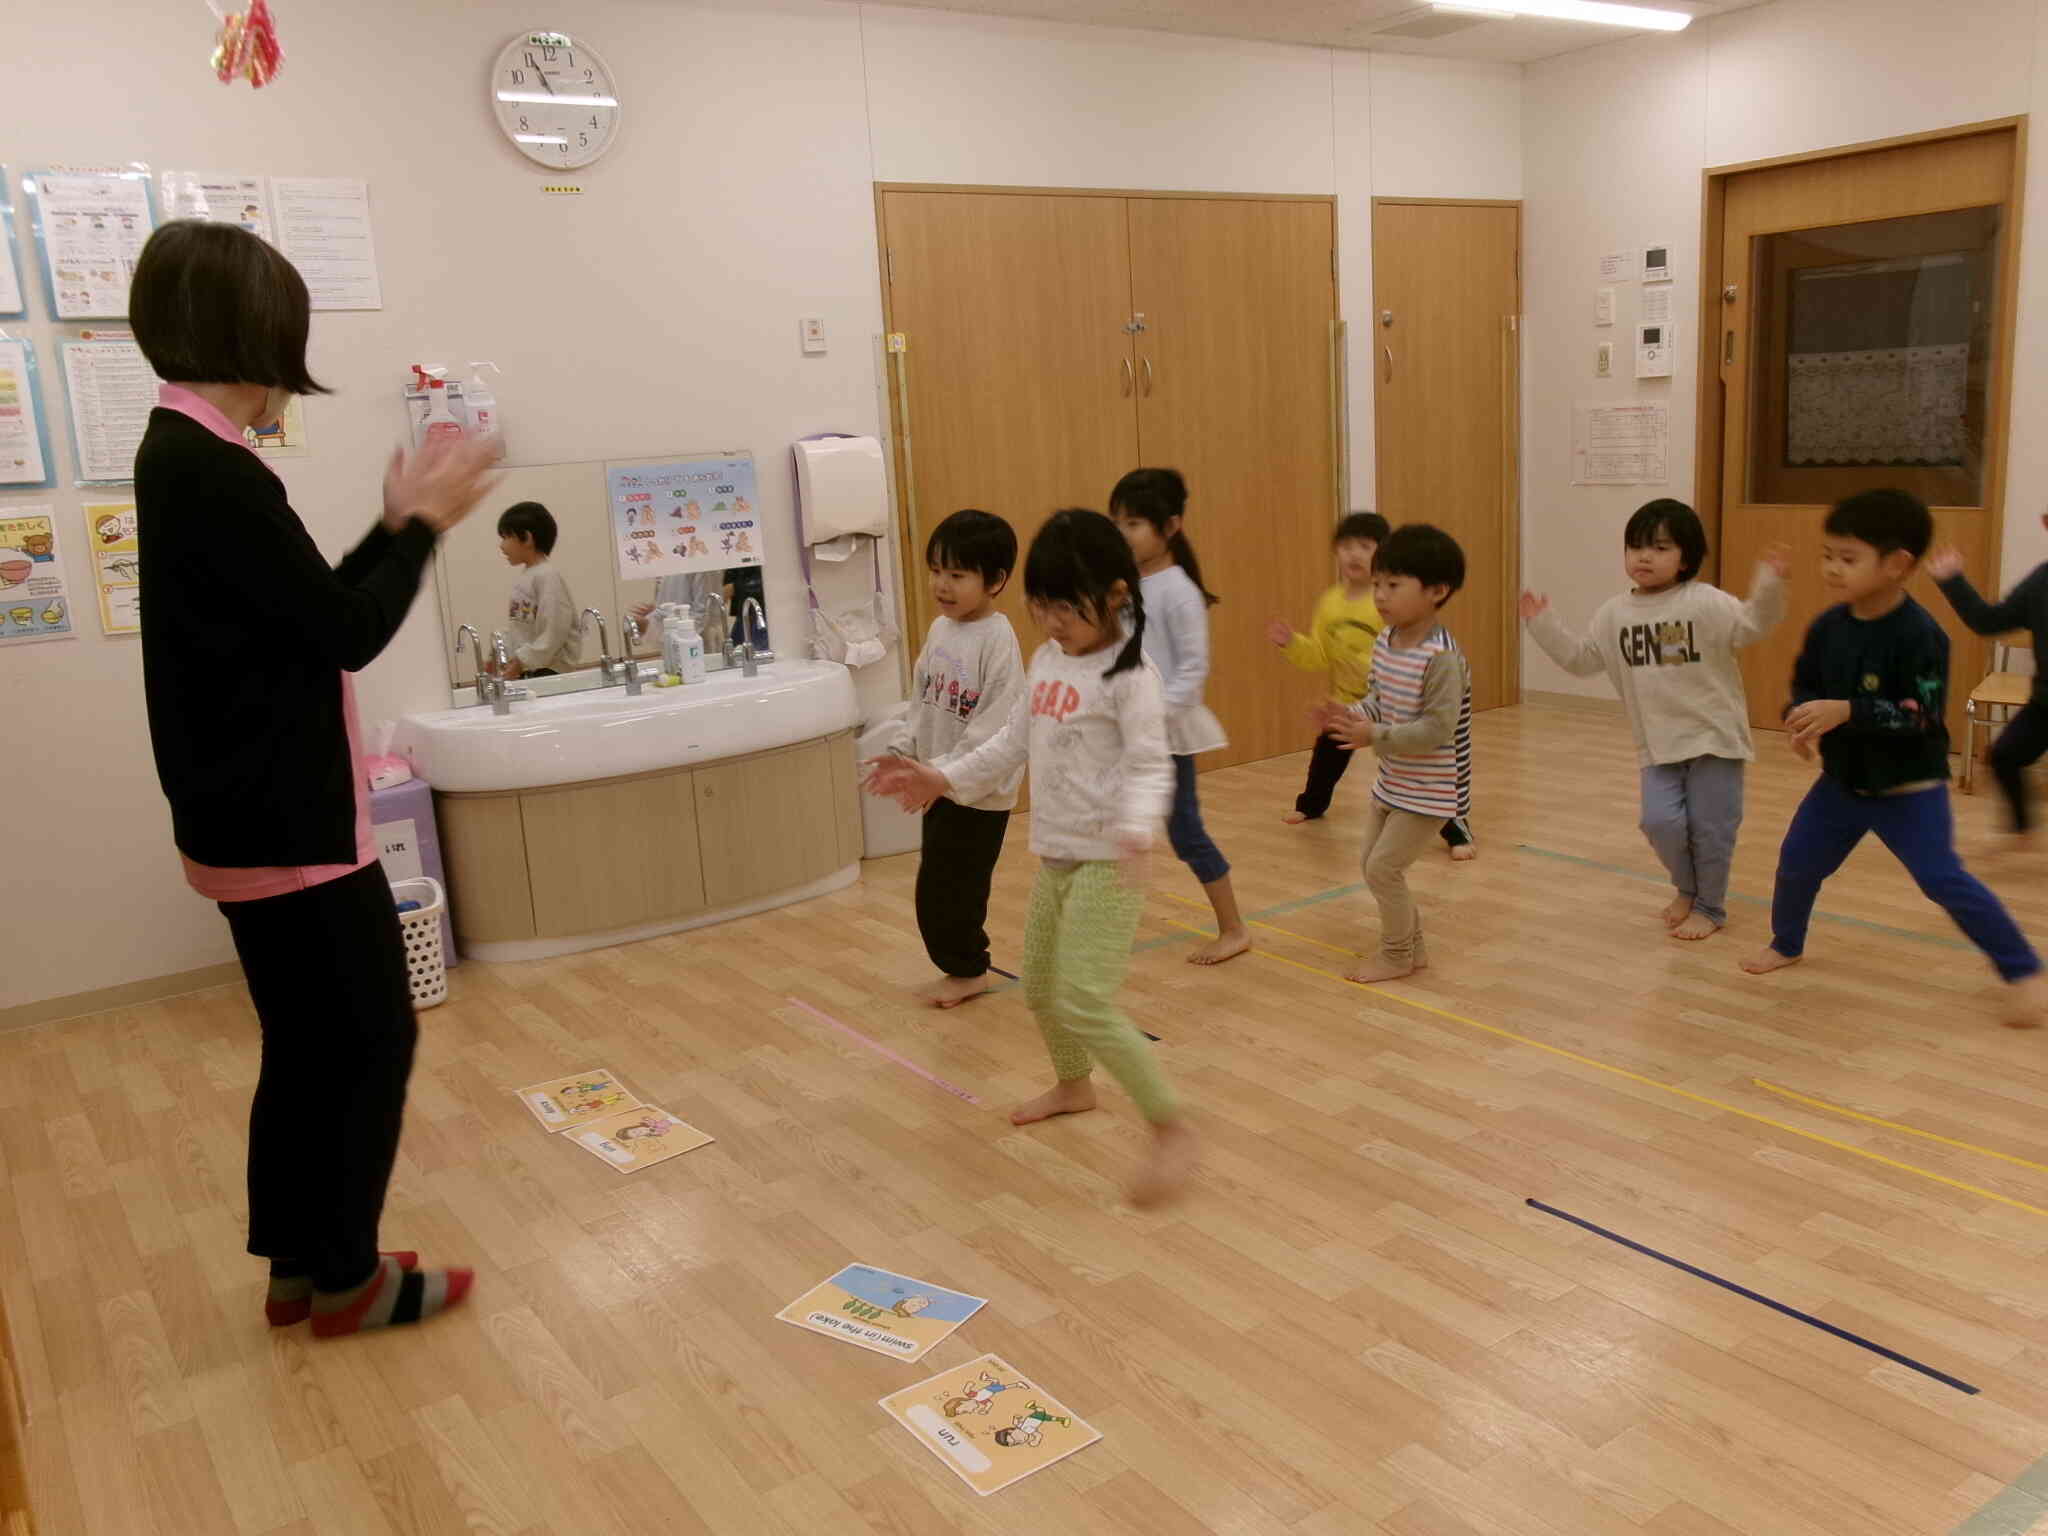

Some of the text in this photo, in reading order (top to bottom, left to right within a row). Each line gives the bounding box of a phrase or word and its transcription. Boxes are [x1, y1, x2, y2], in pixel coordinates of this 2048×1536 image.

[543, 46, 557, 61] 12
[567, 51, 574, 68] 1
[511, 69, 525, 85] 10
[583, 68, 593, 84] 2
[519, 115, 529, 131] 8
[588, 114, 598, 129] 4
[579, 132, 588, 147] 5
[841, 1322, 861, 1335] the
[863, 1328, 882, 1342] (in
[882, 1334, 915, 1350] swim
[938, 1428, 961, 1446] run
